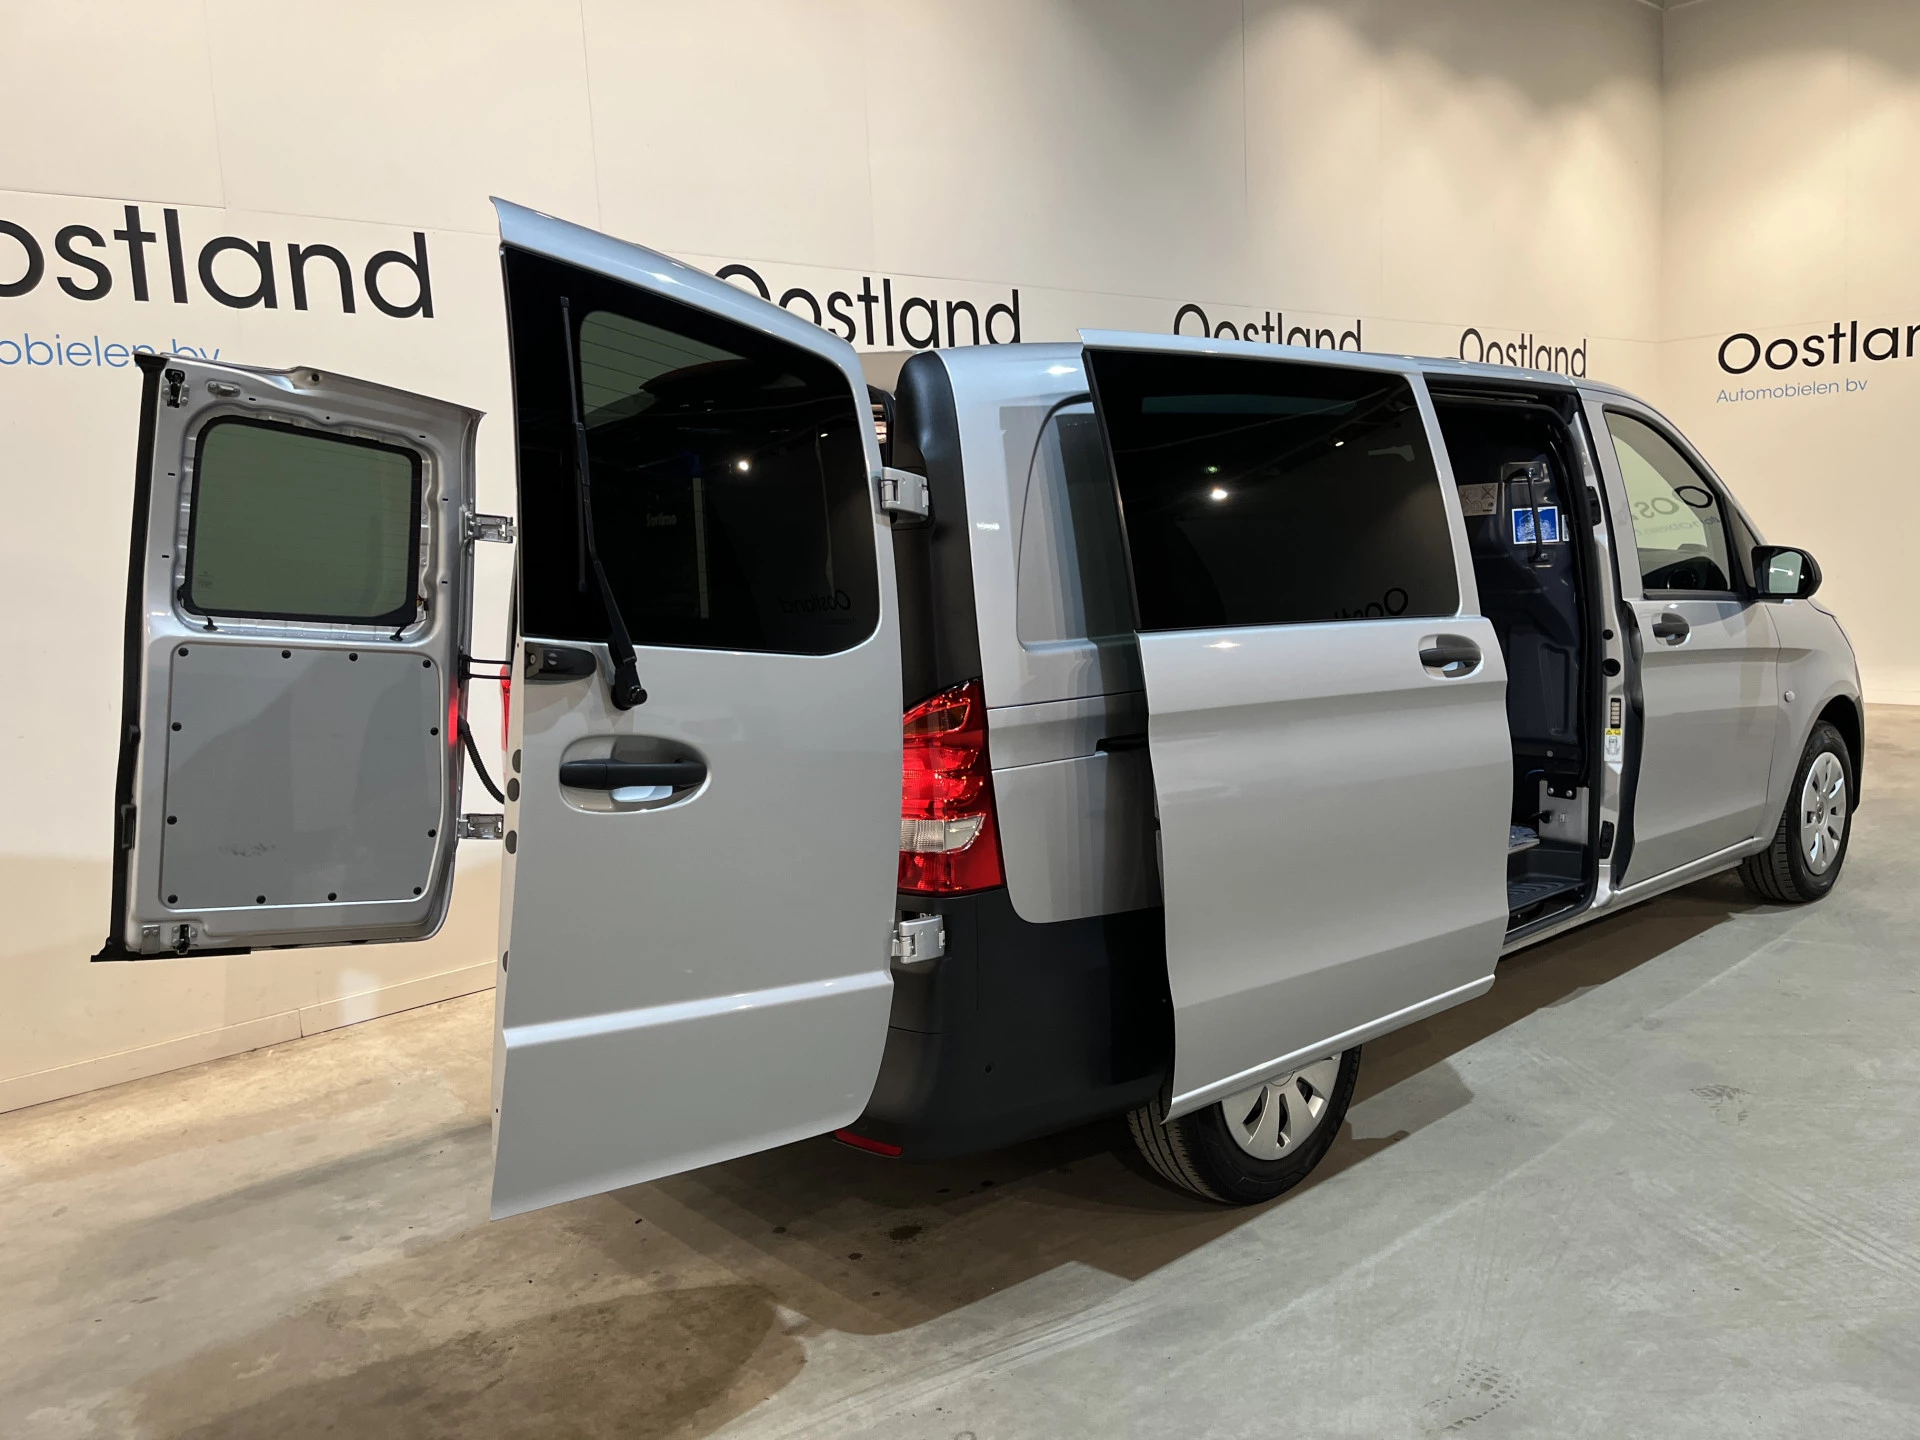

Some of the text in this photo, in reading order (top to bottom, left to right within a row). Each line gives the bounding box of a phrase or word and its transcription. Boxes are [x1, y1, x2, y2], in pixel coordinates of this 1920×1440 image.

[1459, 327, 1586, 378] Oostland
[1716, 378, 1868, 403] Automobielen bv
